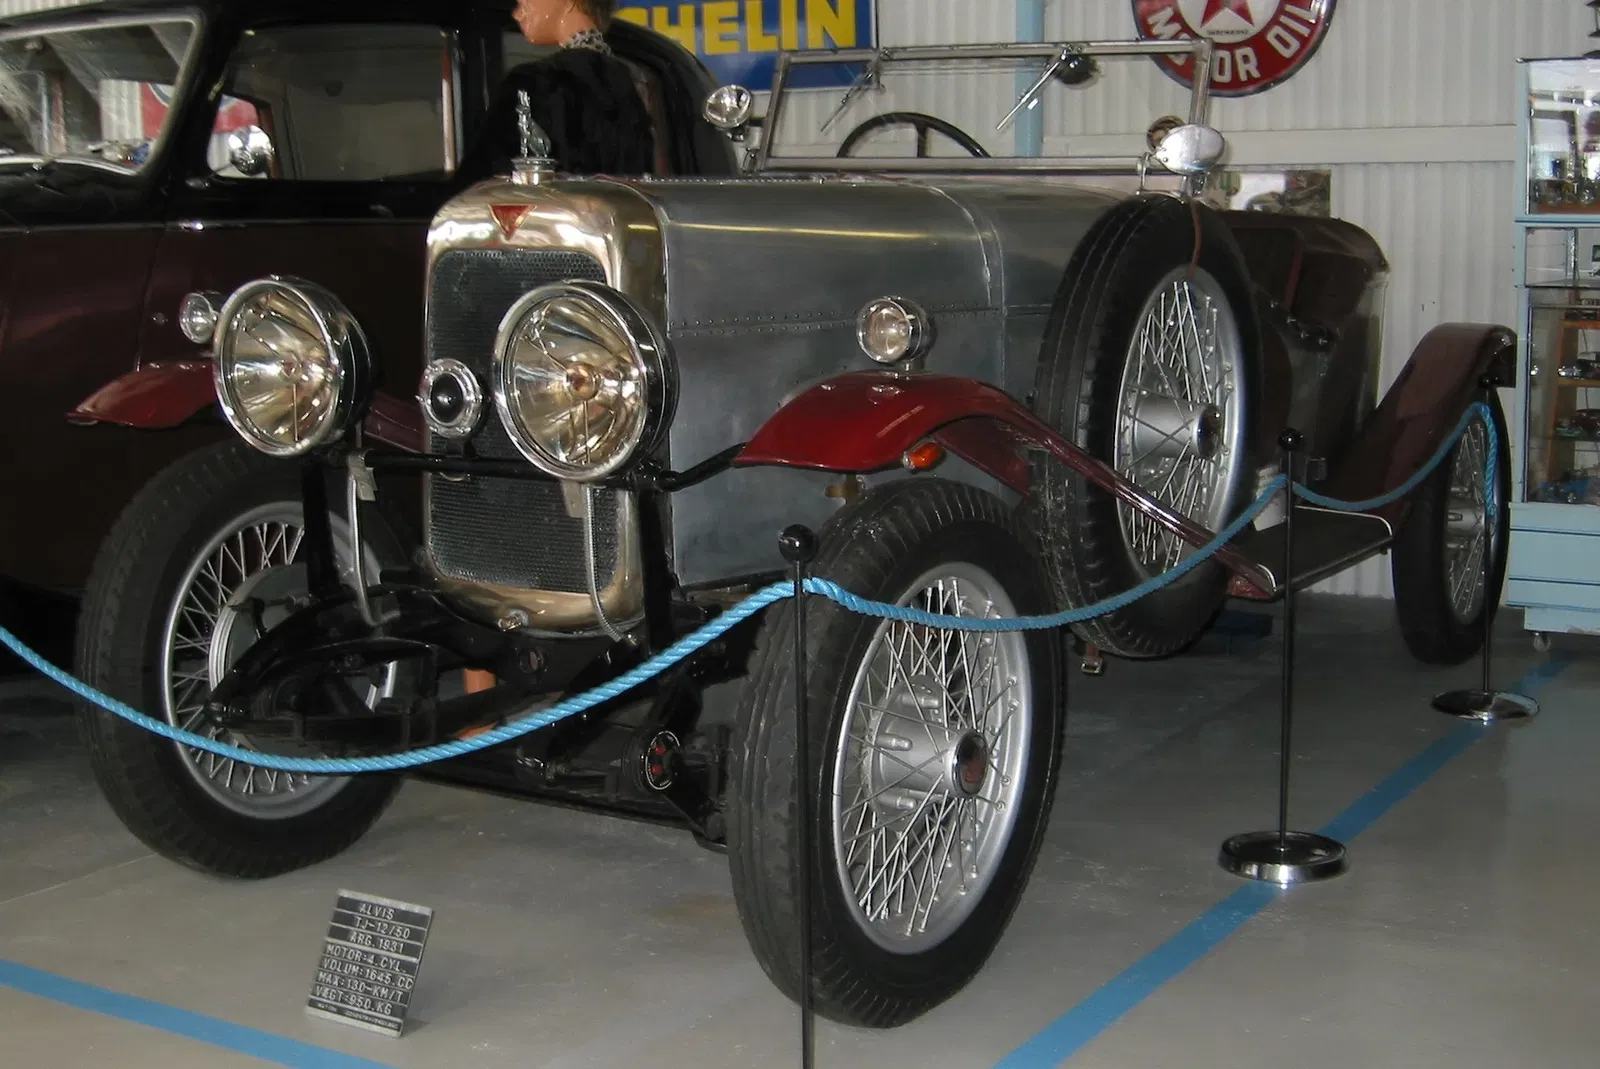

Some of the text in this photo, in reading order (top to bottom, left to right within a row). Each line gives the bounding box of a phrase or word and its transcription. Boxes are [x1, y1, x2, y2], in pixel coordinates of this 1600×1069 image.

[1147, 0, 1318, 84] MOR OIL
[359, 903, 395, 920] ALVIS
[355, 917, 411, 940] TJ-12/50
